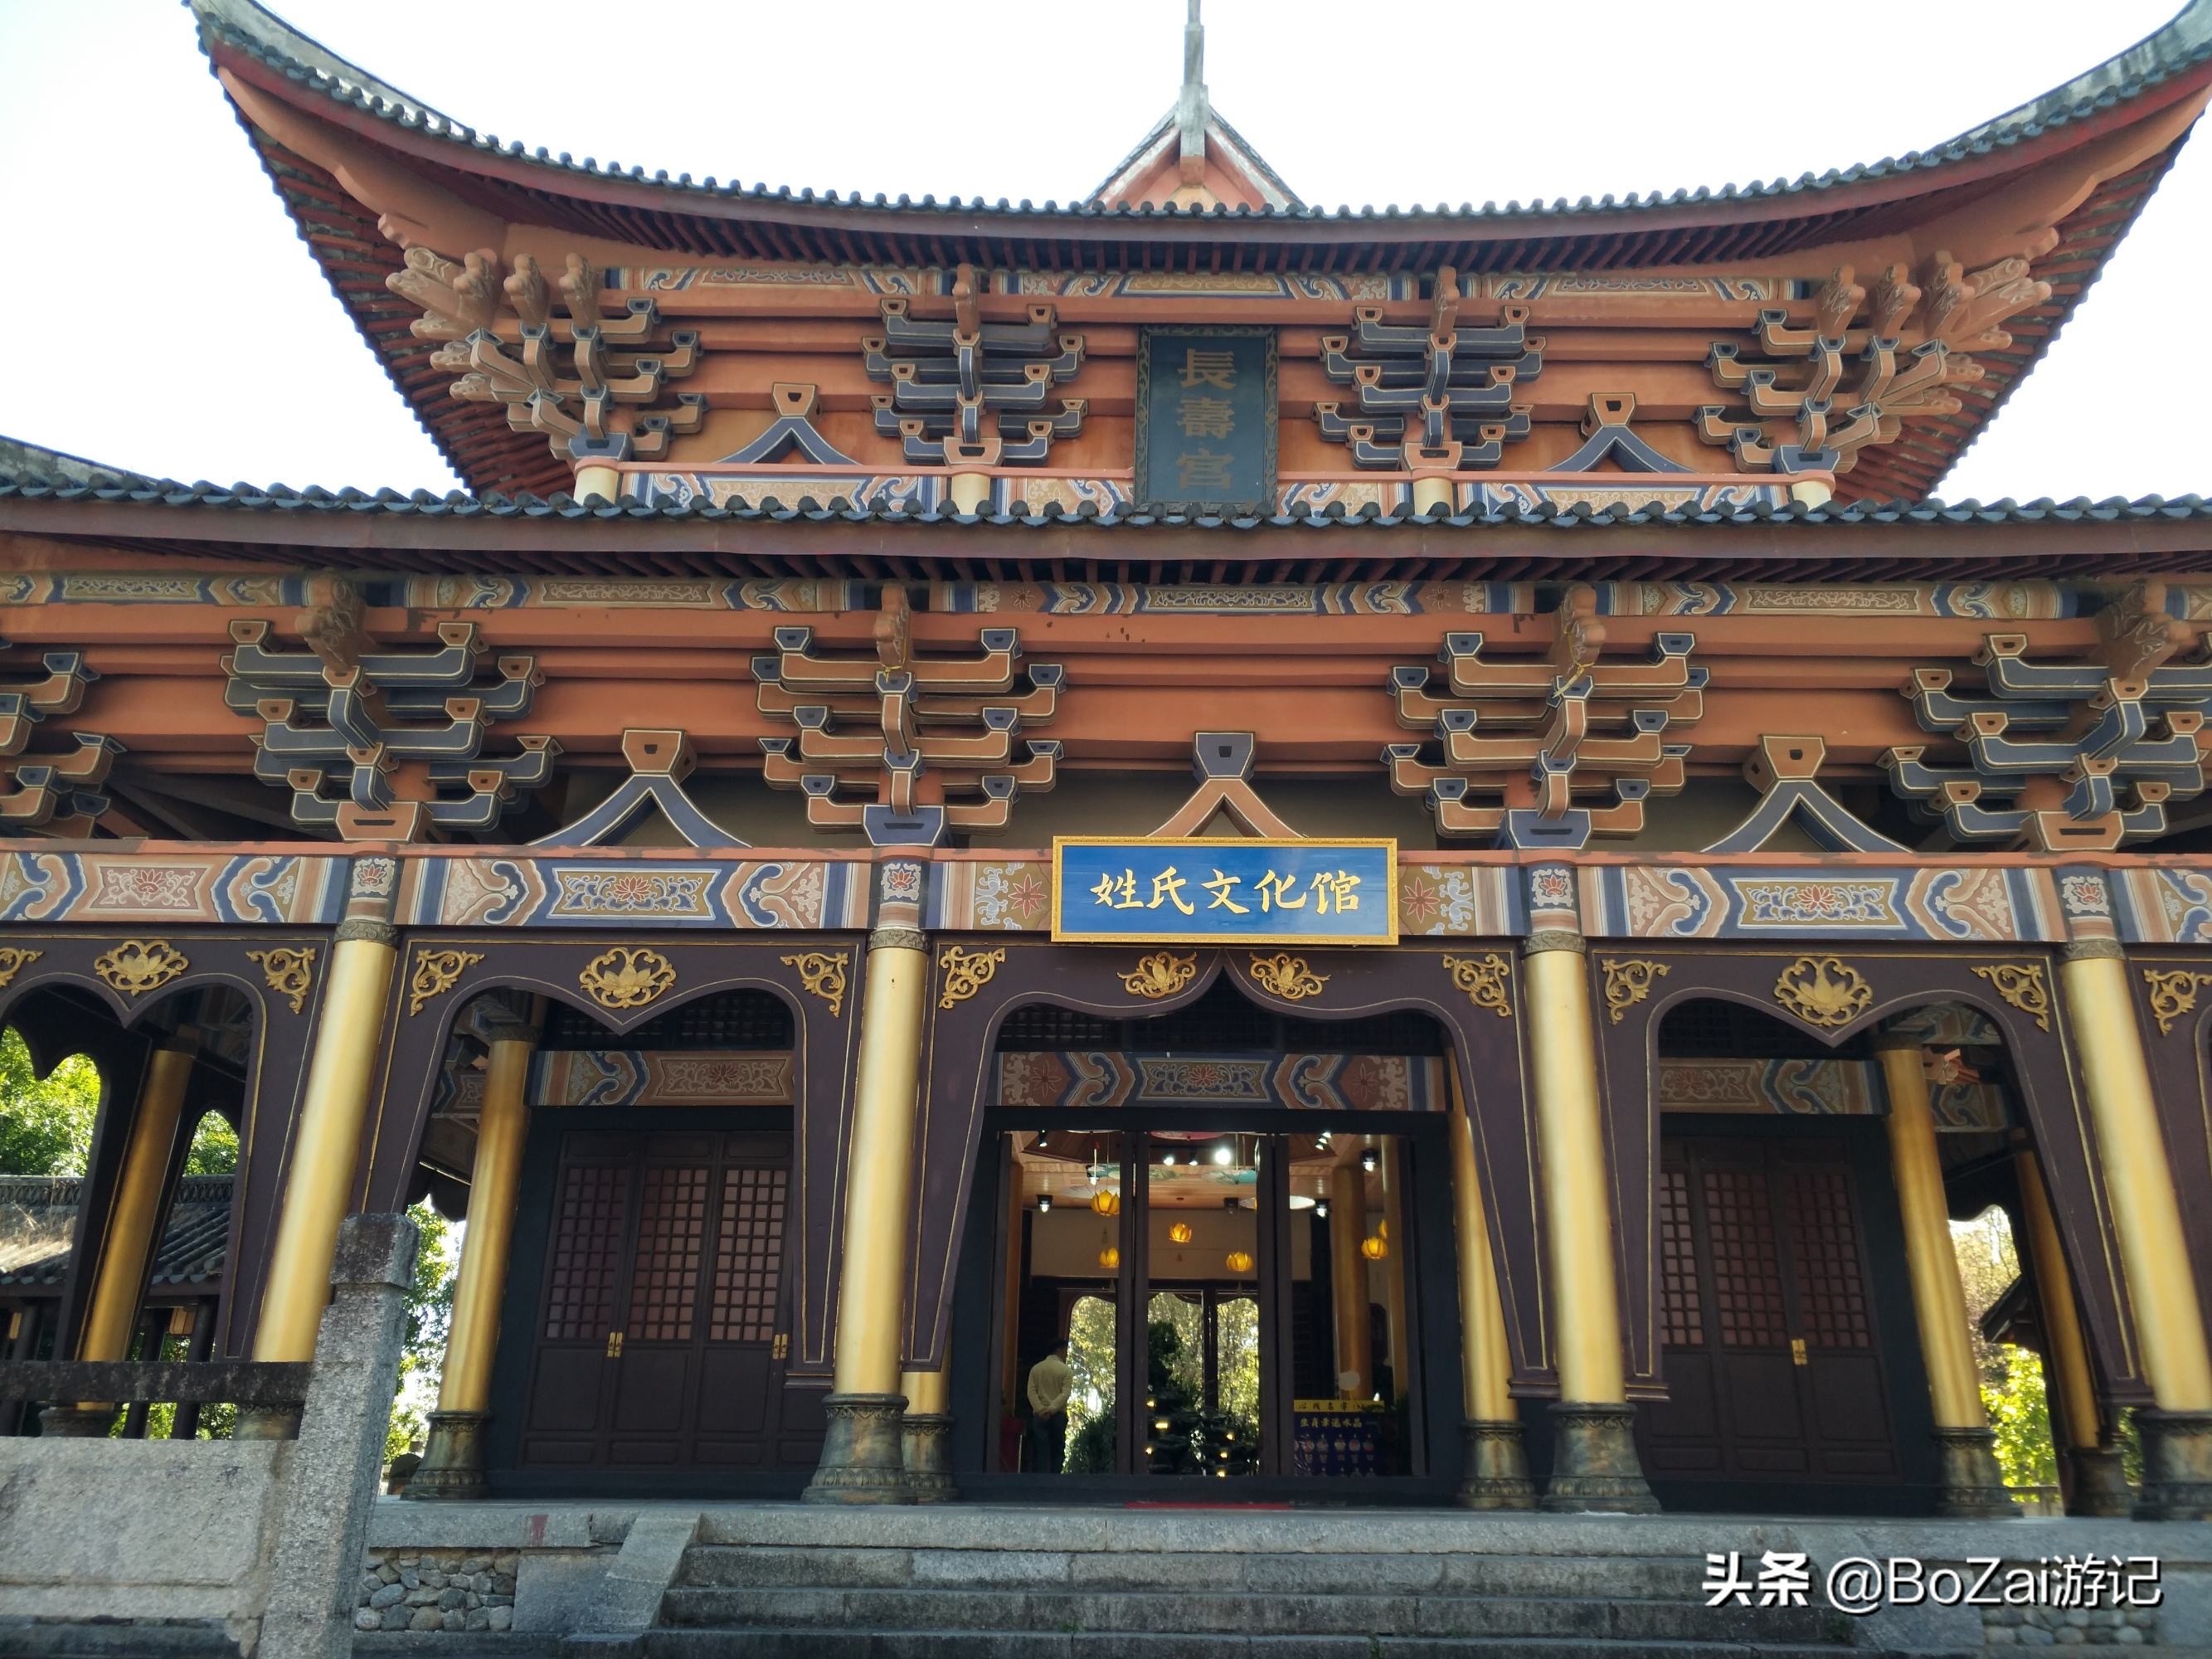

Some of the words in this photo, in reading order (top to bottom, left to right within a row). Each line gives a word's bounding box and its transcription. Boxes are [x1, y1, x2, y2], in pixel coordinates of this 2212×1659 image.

[1089, 866, 1362, 915] 姓氏文化馆
